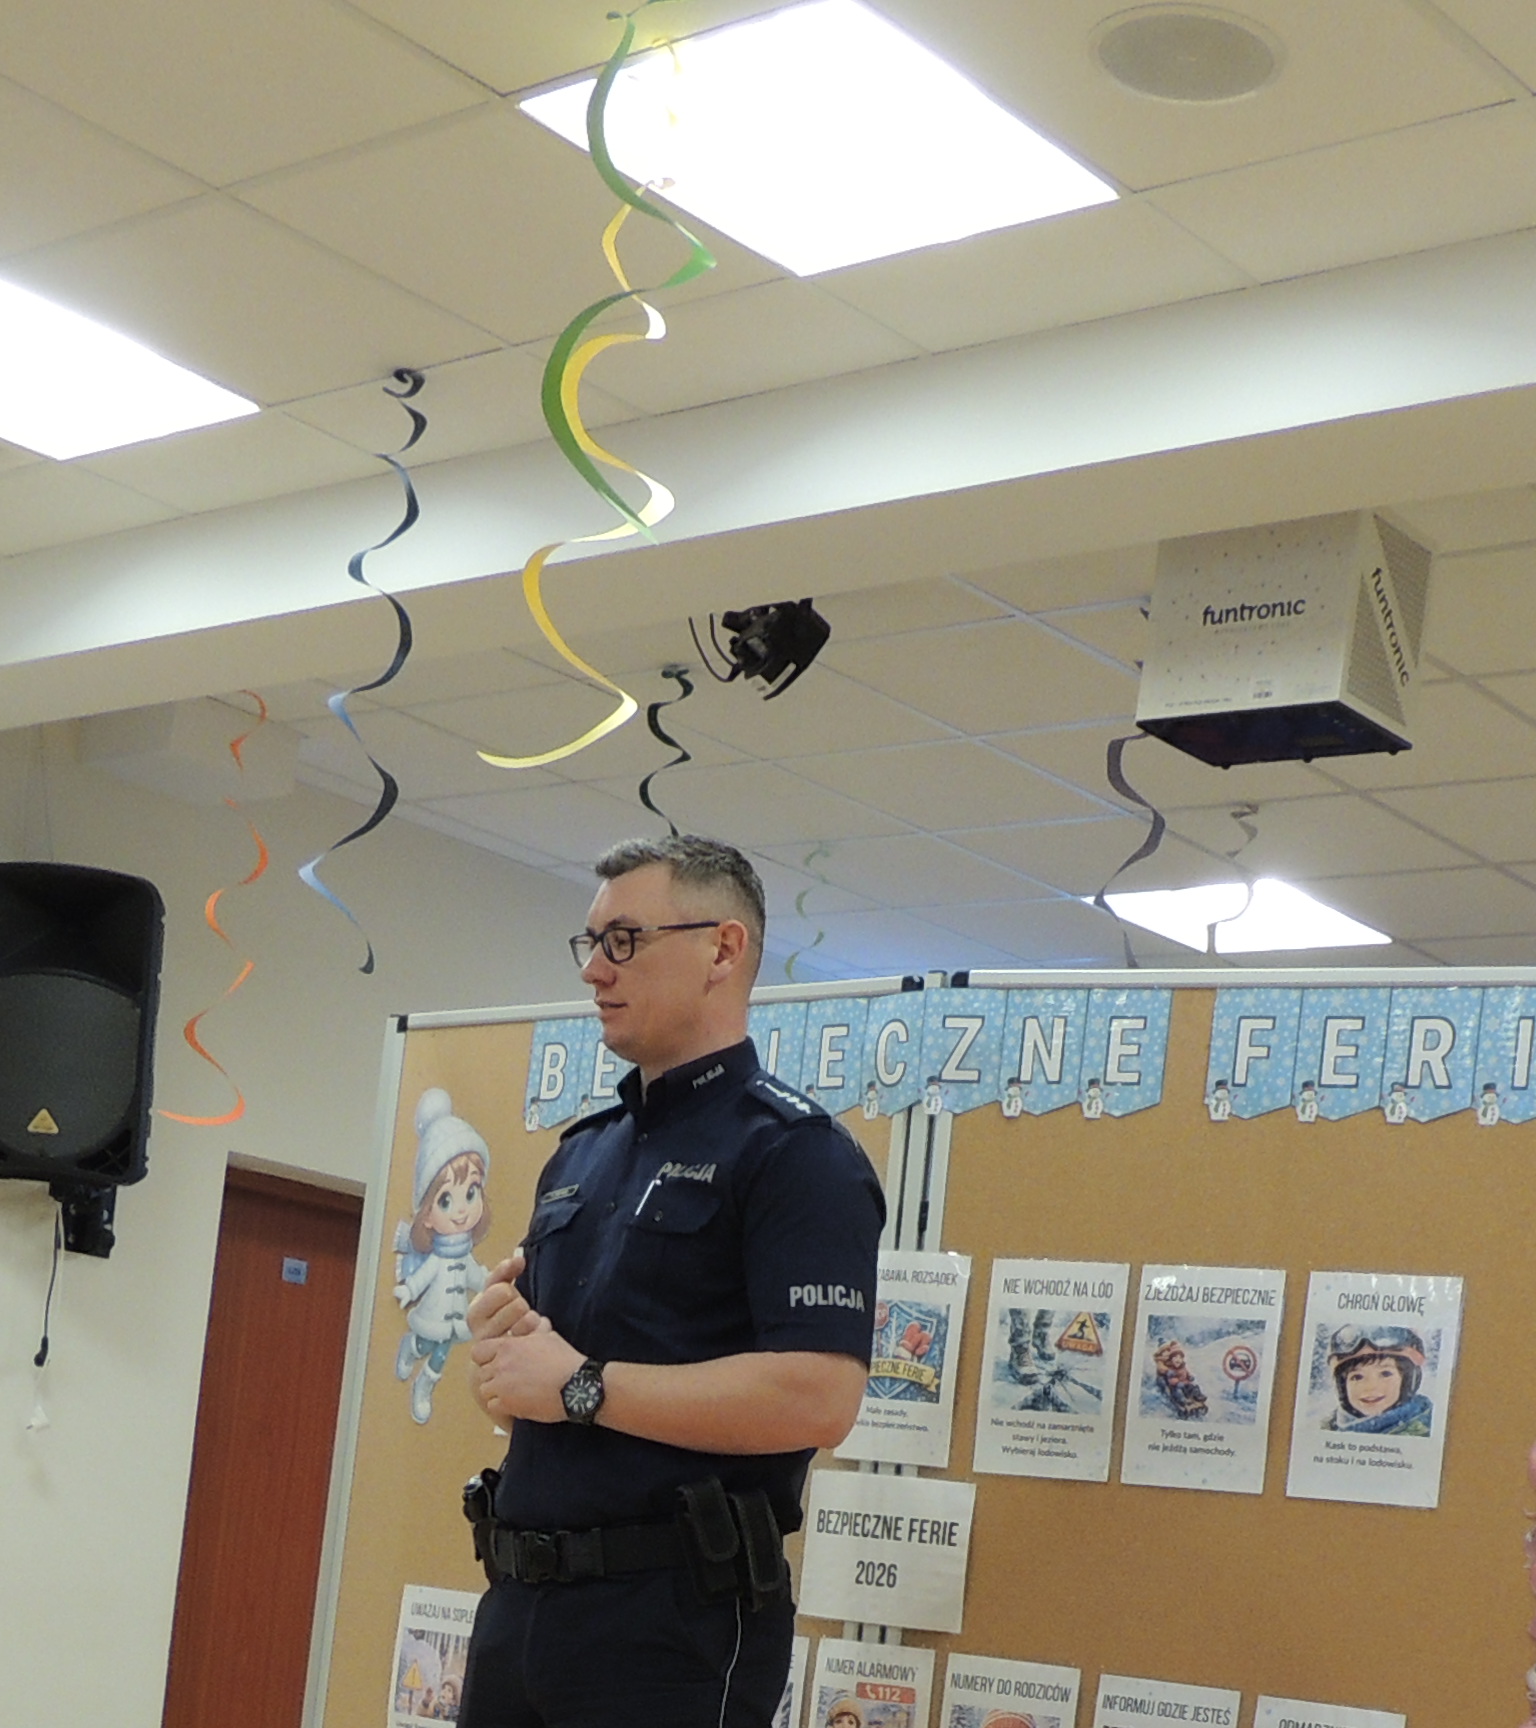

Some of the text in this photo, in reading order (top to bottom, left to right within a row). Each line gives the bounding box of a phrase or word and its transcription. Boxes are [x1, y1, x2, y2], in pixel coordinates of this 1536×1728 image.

[1202, 599, 1306, 626] funtronic
[1370, 567, 1410, 687] funtronic
[538, 1016, 1147, 1101] BEIECZNE
[911, 1270, 959, 1286] ROZSĄDEK
[1002, 1277, 1114, 1299] NIE WCHODŹ NA LÓD
[789, 1284, 865, 1312] POLICJA
[1202, 1286, 1277, 1306] BEZPIECZNIE
[1337, 1291, 1426, 1317] CHROŃ GŁOWĘ
[990, 1418, 1004, 1427] Nie
[1012, 1434, 1035, 1443] stawy
[1161, 1428, 1224, 1443] Tylko tam, gdzie
[1325, 1440, 1345, 1450] Kask
[1348, 1442, 1357, 1451] to
[1001, 1445, 1036, 1457] Wybieraj
[1148, 1442, 1160, 1451] nie
[1189, 1446, 1236, 1458] samochody.
[1326, 1455, 1349, 1465] stoku
[1356, 1458, 1366, 1466] na
[816, 1508, 960, 1547] BEZPIECZNE FERIE
[855, 1560, 898, 1588] 2026
[825, 1656, 919, 1682] NUMER ALARMOWY
[877, 1687, 901, 1701] 112
[950, 1672, 1073, 1704] NUMERY DO RODZICÓW
[1102, 1694, 1232, 1726] INFORMUJ GDZIE JESTEŚ
